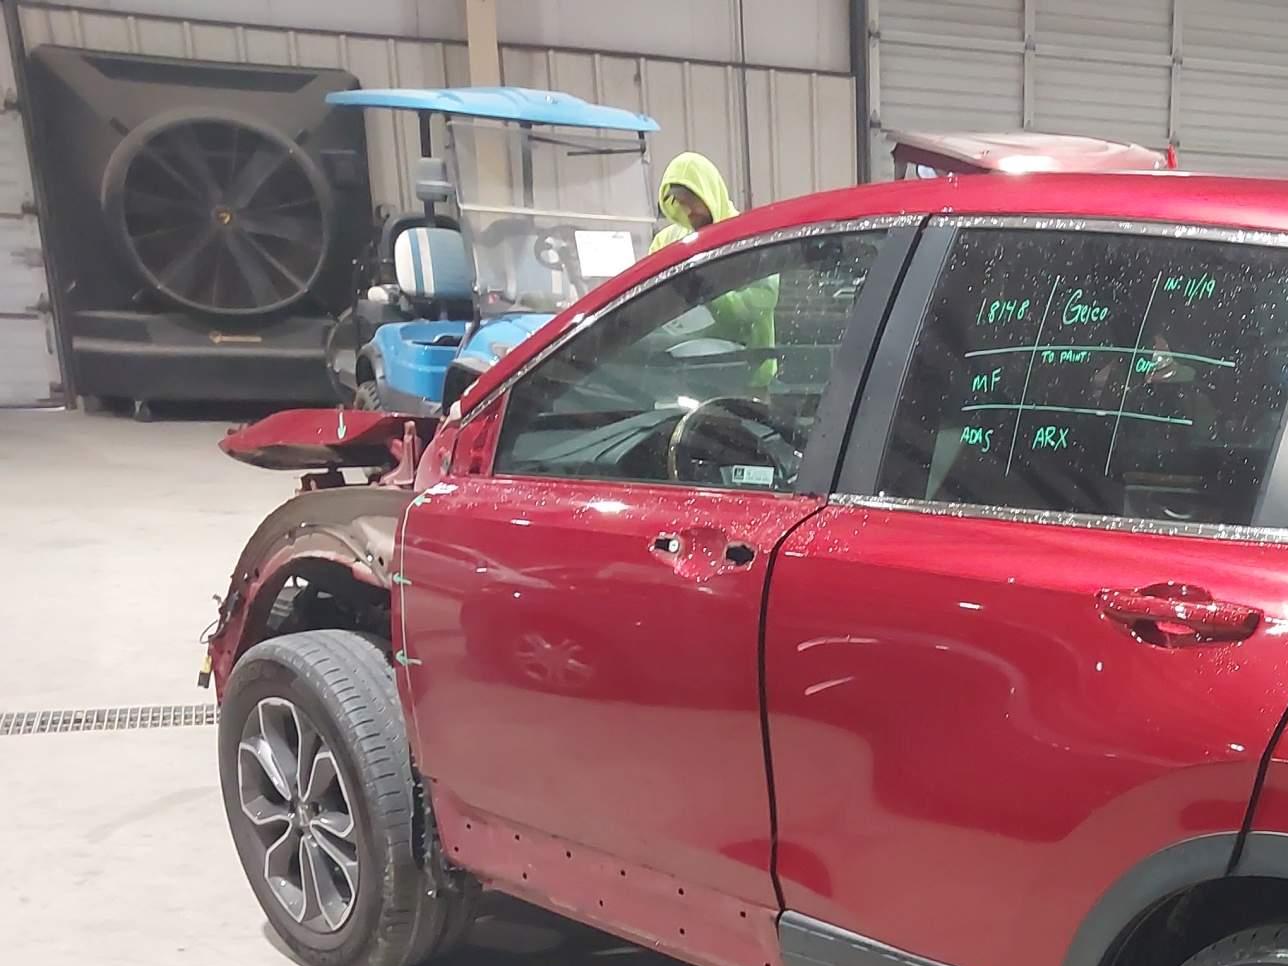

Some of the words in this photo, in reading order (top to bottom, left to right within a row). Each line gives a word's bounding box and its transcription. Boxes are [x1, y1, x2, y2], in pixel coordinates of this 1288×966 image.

[1183, 272, 1216, 305] 11/19
[972, 367, 1002, 393] MF
[959, 425, 994, 453] ADAS
[1031, 425, 1070, 452] ARX
